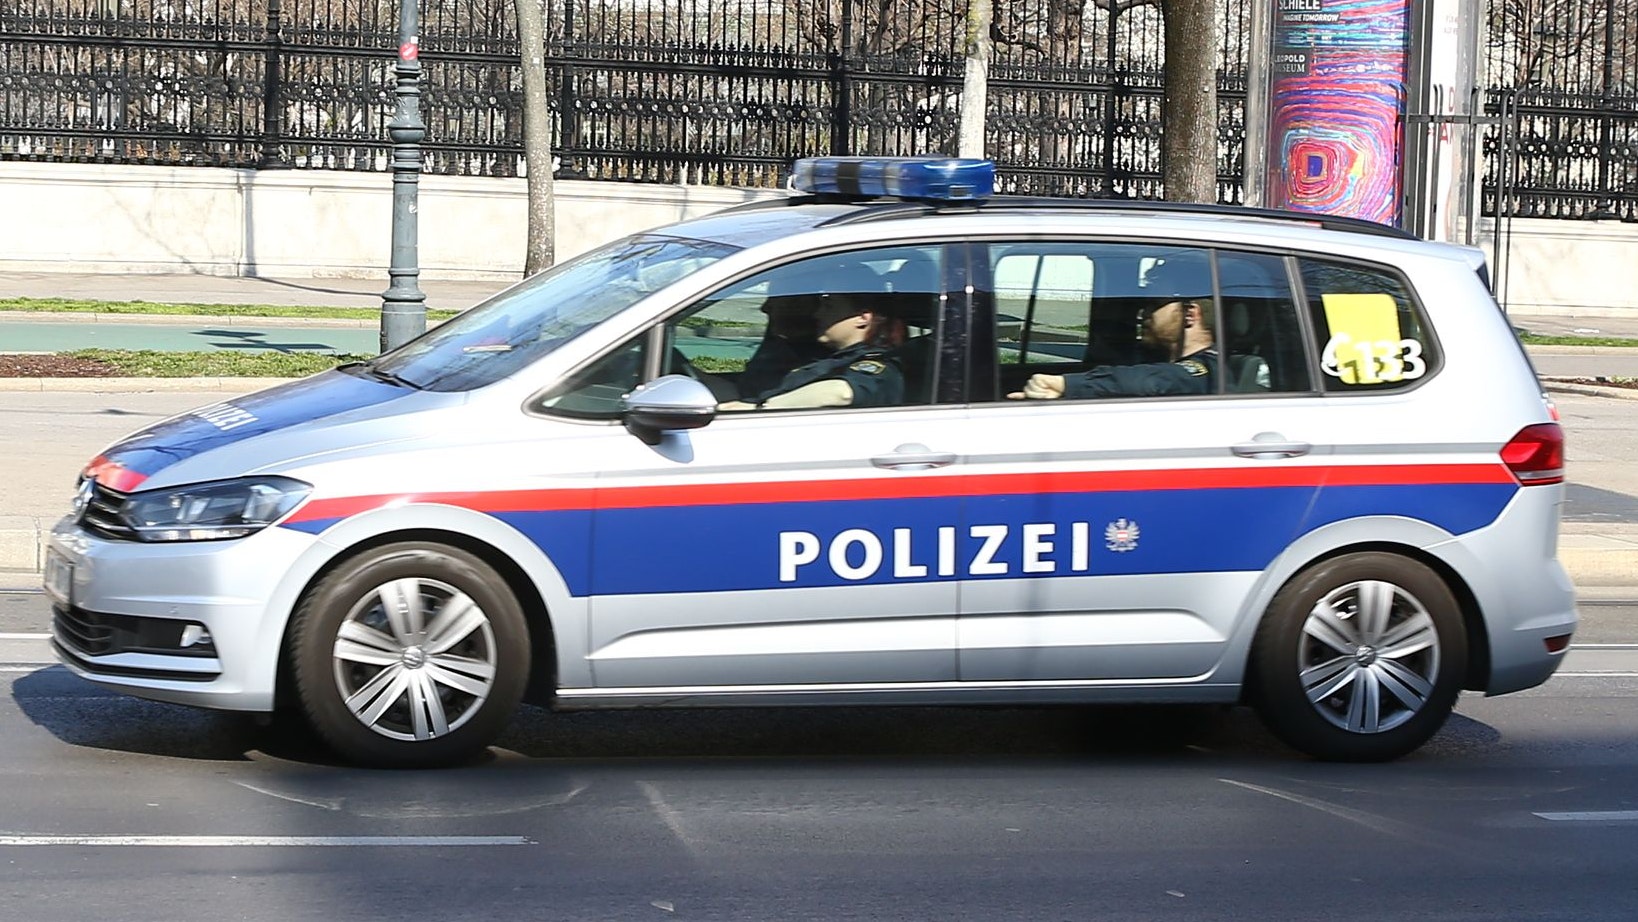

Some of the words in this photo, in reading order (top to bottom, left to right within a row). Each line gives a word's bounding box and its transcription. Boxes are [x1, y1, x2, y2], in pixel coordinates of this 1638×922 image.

[1279, 0, 1320, 10] SCHIELE
[1276, 63, 1305, 73] SEUM
[1355, 338, 1427, 380] 133
[778, 521, 1089, 582] POLIZEI
